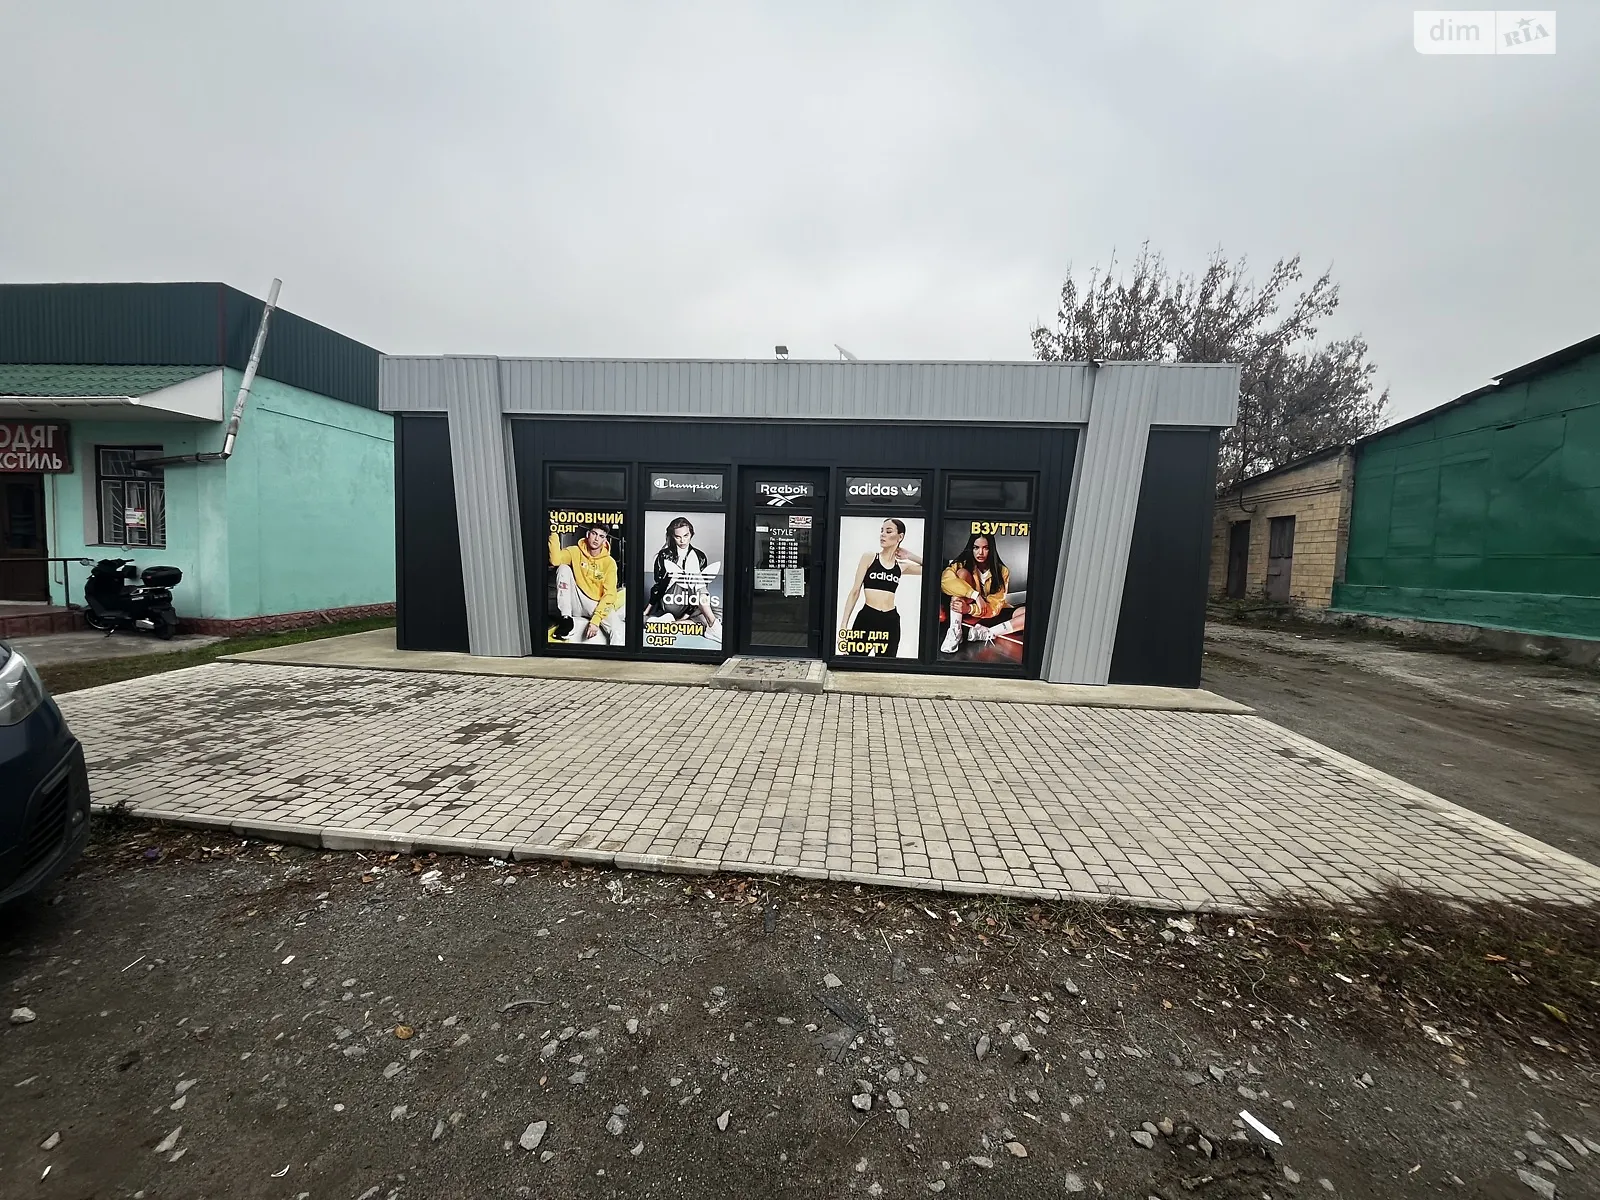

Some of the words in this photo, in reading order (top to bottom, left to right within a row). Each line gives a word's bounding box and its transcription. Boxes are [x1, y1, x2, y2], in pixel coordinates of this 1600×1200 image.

[0, 424, 58, 452] ОДЯГ
[653, 478, 720, 493] Champion
[760, 484, 808, 495] Reebok
[849, 482, 899, 497] adidas
[549, 511, 624, 525] ЧОЛОВІЧИЙ
[550, 523, 579, 534] ОДЯГ
[971, 521, 1029, 537] ВЗУТТЯ
[662, 590, 720, 607] adidas
[646, 622, 704, 635] ЖІНОЧИЙ
[839, 629, 866, 641] ОДЯГ
[867, 630, 890, 642] ДЛЯ
[647, 635, 676, 646] ОДЯГ
[839, 641, 889, 655] СПОРТУ
